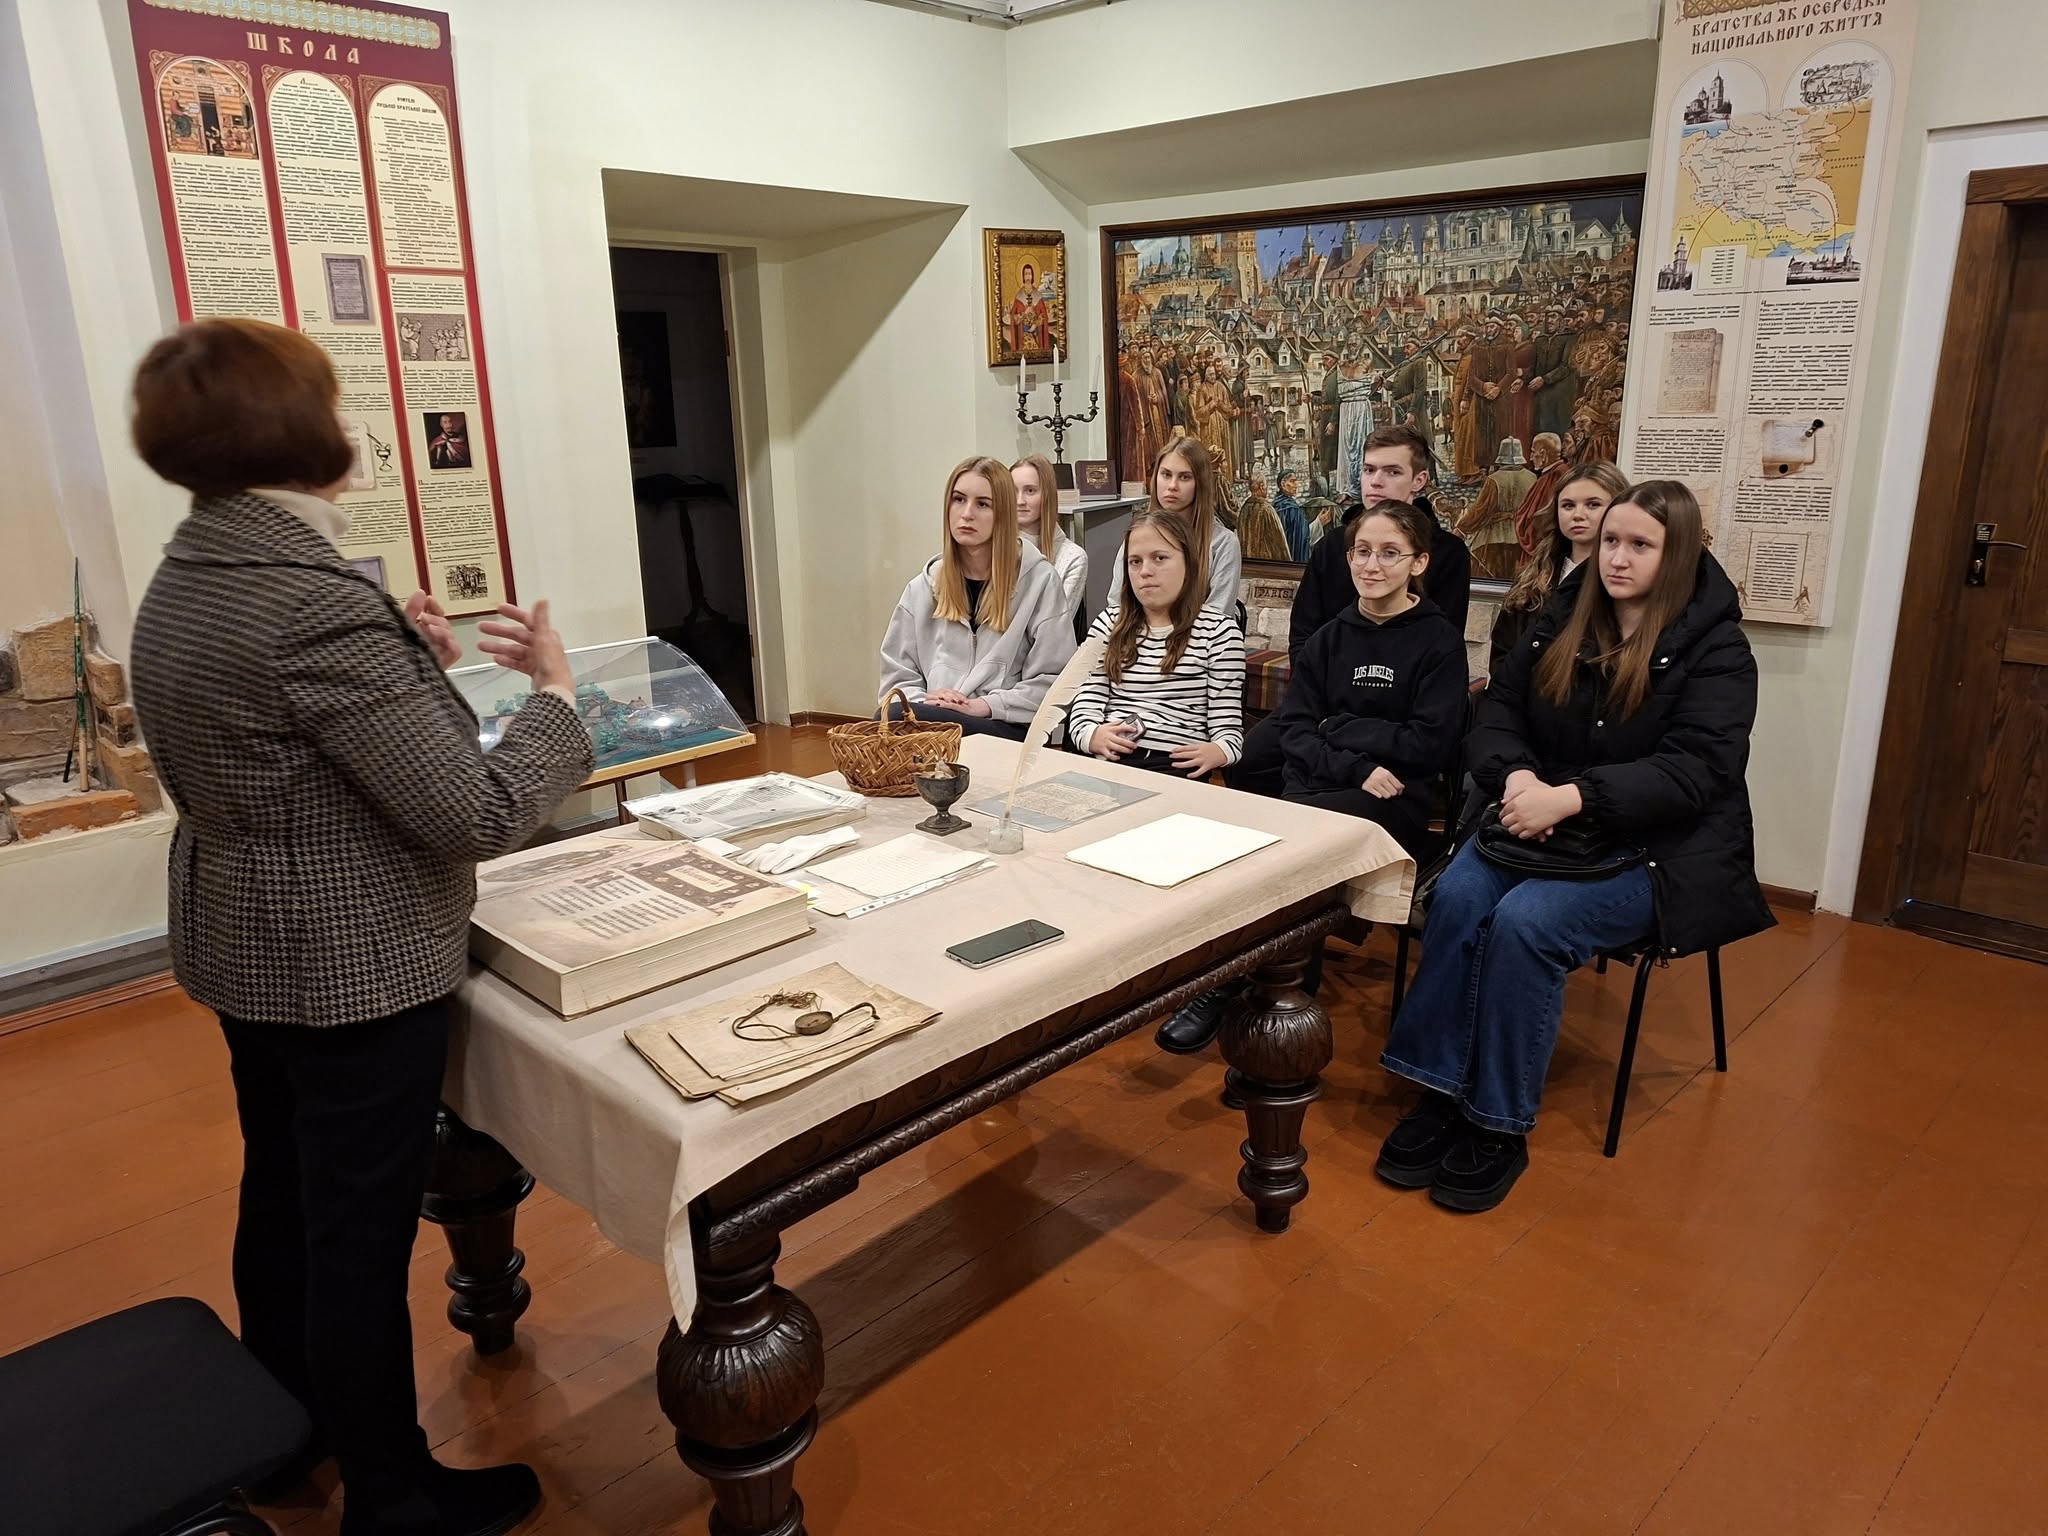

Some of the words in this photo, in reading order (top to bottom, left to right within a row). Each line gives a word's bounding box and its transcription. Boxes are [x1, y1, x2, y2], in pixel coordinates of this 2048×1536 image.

[1691, 23, 1814, 55] НАЦІОНАЛЬНОГО
[1818, 11, 1882, 34] ЖИТТЯ
[1692, 11, 1773, 37] БРАТСТВА
[1777, 7, 1798, 23] ЯК
[246, 31, 360, 65] ШКОЛА
[1353, 665, 1367, 680] LOS
[1367, 664, 1394, 682] ANGELES
